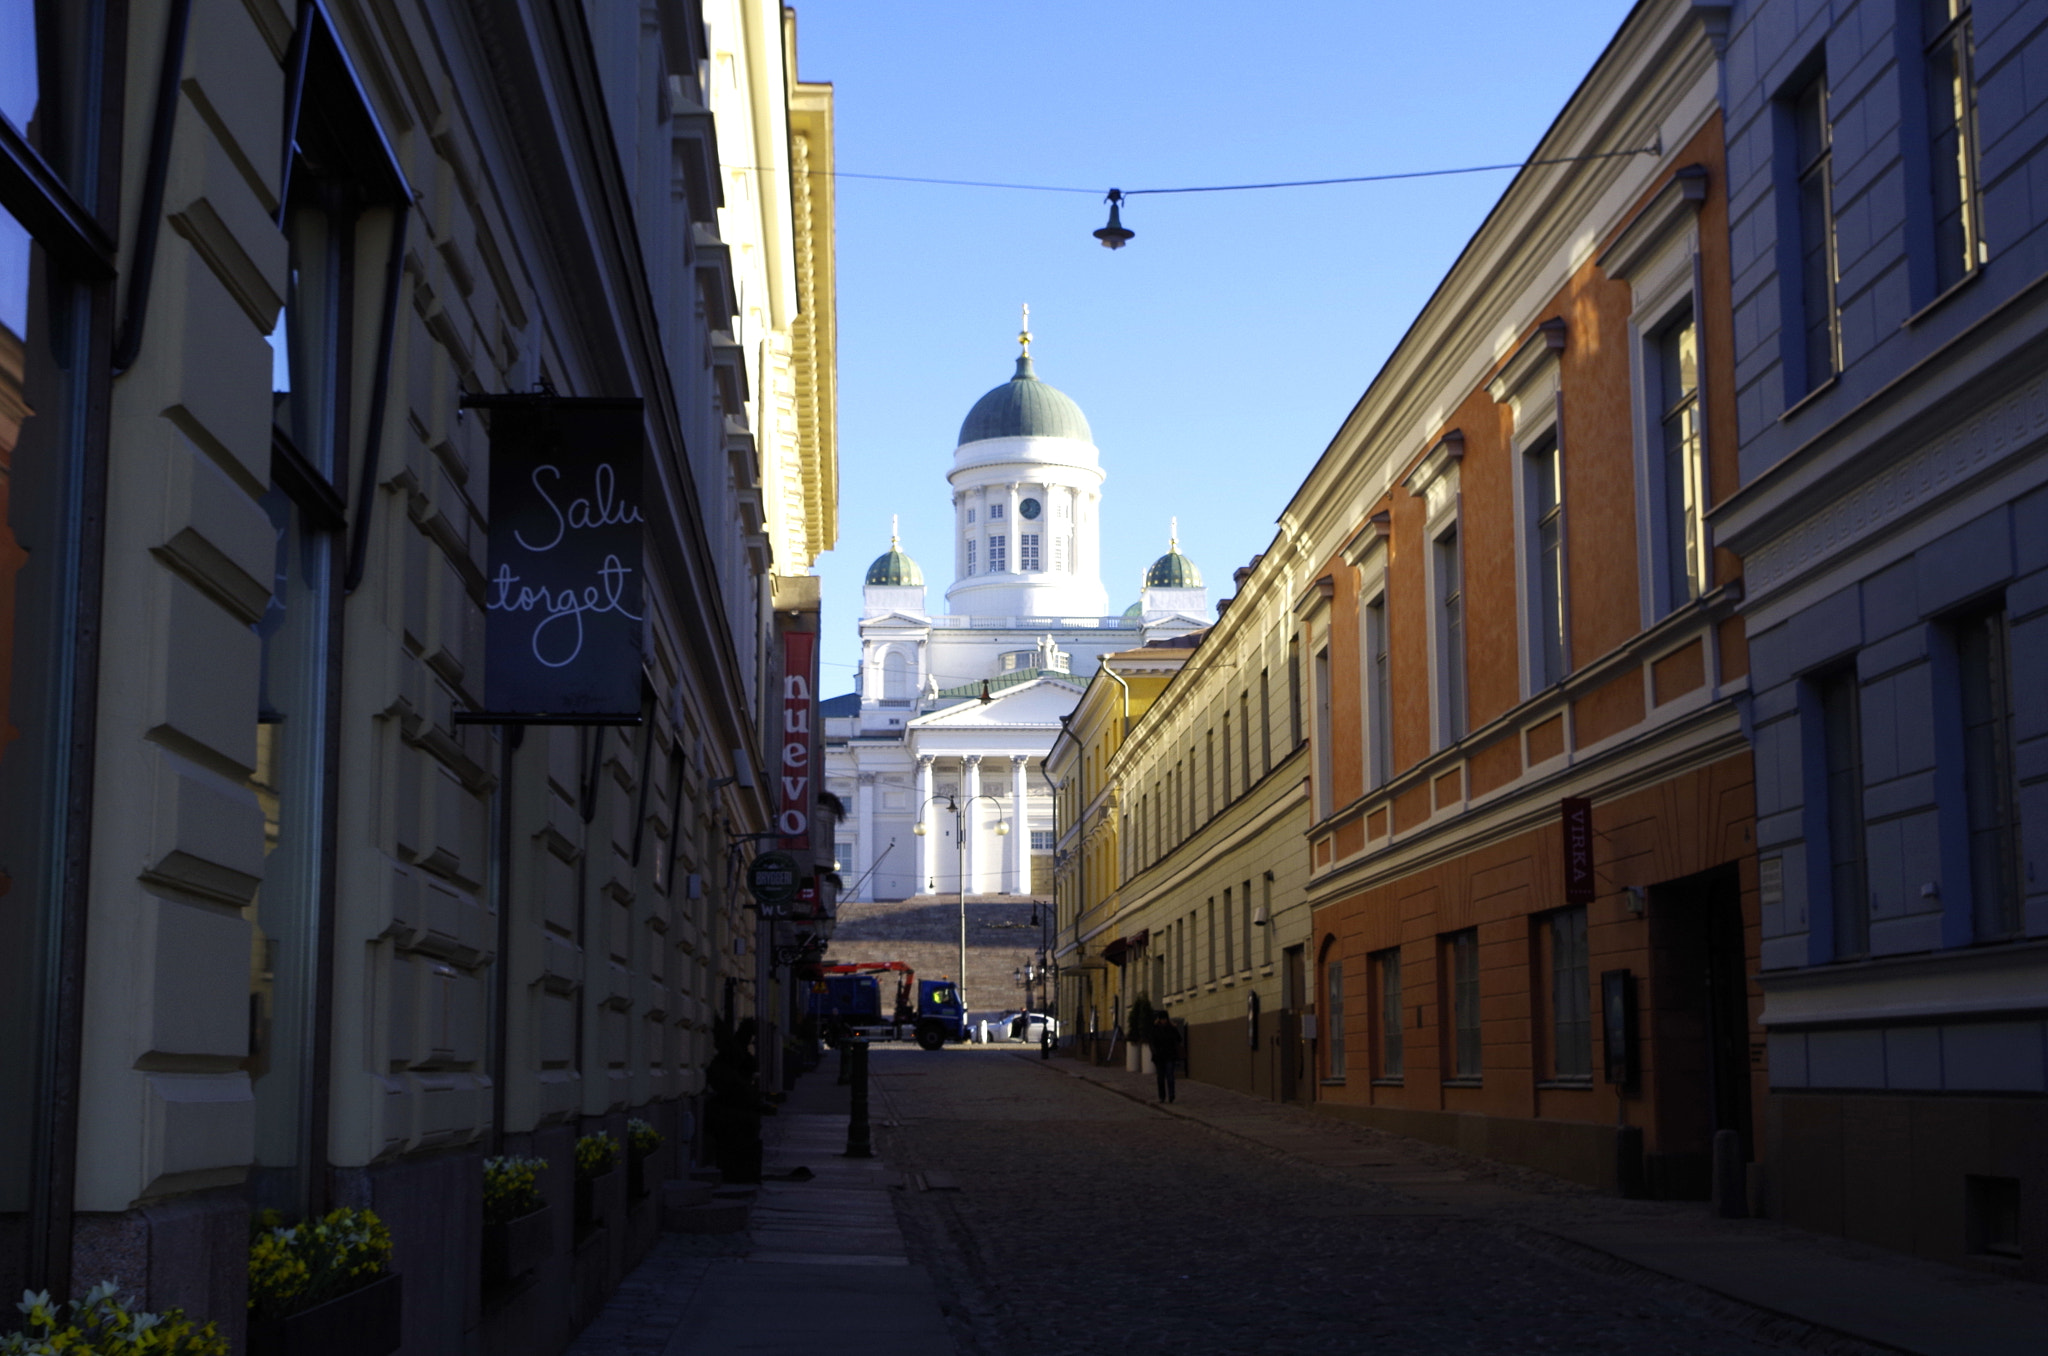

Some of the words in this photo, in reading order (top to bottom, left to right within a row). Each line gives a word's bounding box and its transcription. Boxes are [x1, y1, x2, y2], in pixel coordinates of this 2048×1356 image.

[514, 462, 644, 551] Salu
[486, 554, 643, 668] torget
[780, 674, 810, 836] nuevo
[1571, 808, 1587, 882] VIRKA
